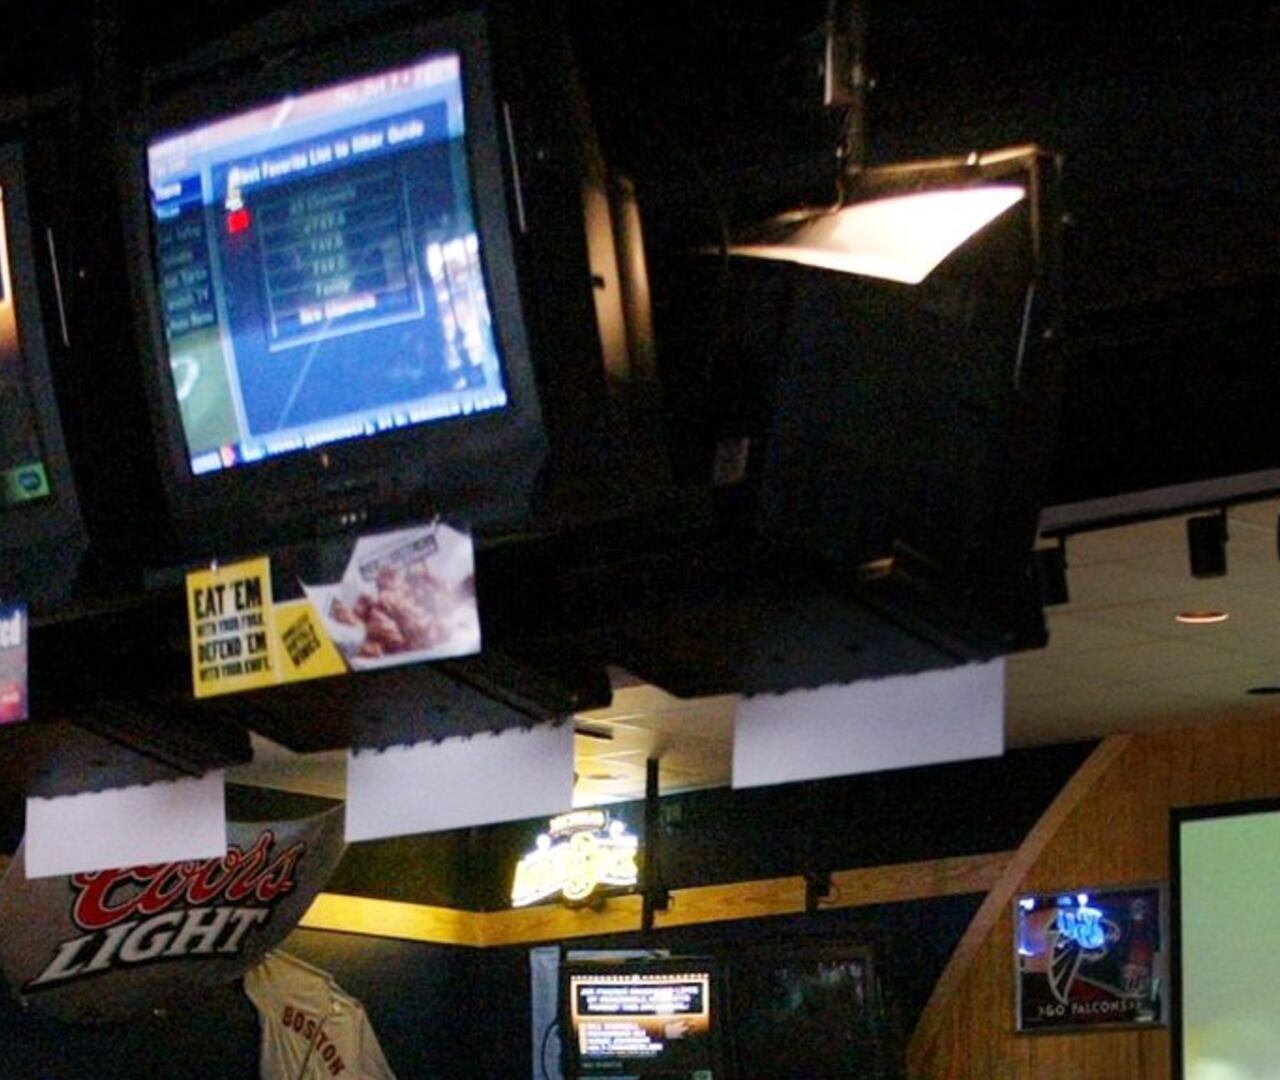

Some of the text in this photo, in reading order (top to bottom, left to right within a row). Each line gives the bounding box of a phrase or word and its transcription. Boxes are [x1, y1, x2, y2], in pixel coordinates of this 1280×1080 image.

[193, 585, 225, 620] EAT
[197, 636, 242, 664] DEFEND
[29, 908, 269, 988] LIGHT
[281, 1004, 347, 1077] BOSTON
